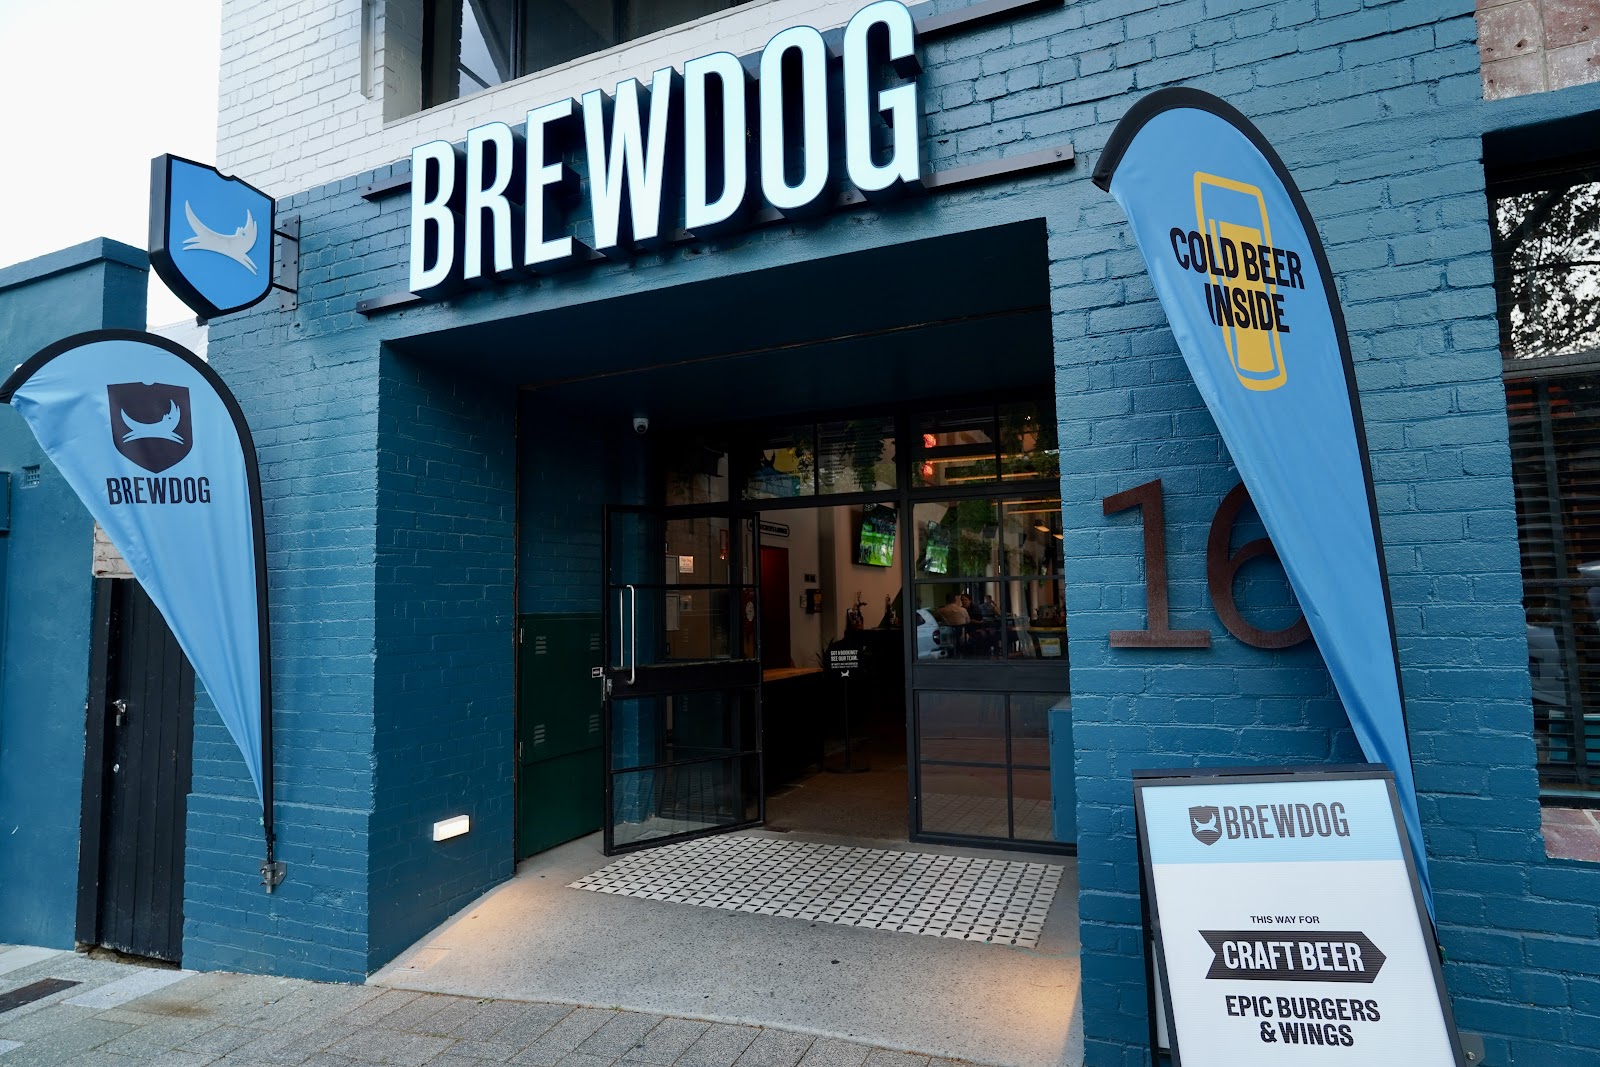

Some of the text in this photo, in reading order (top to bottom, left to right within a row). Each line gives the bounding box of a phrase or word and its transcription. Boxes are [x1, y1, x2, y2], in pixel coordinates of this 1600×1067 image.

[409, 0, 921, 292] BREWDOG
[1169, 227, 1305, 290] COLD BEER
[1204, 283, 1290, 333] INSIDE
[106, 476, 211, 505] BREWDOG
[1102, 478, 1313, 649] 16
[1223, 802, 1350, 840] BREWDOG
[1250, 915, 1320, 924] THIS WAY FOR
[1222, 940, 1365, 972] CRAFT BEER
[1225, 995, 1381, 1022] EPIC BURGERS
[1259, 1021, 1354, 1047] & WINGS
